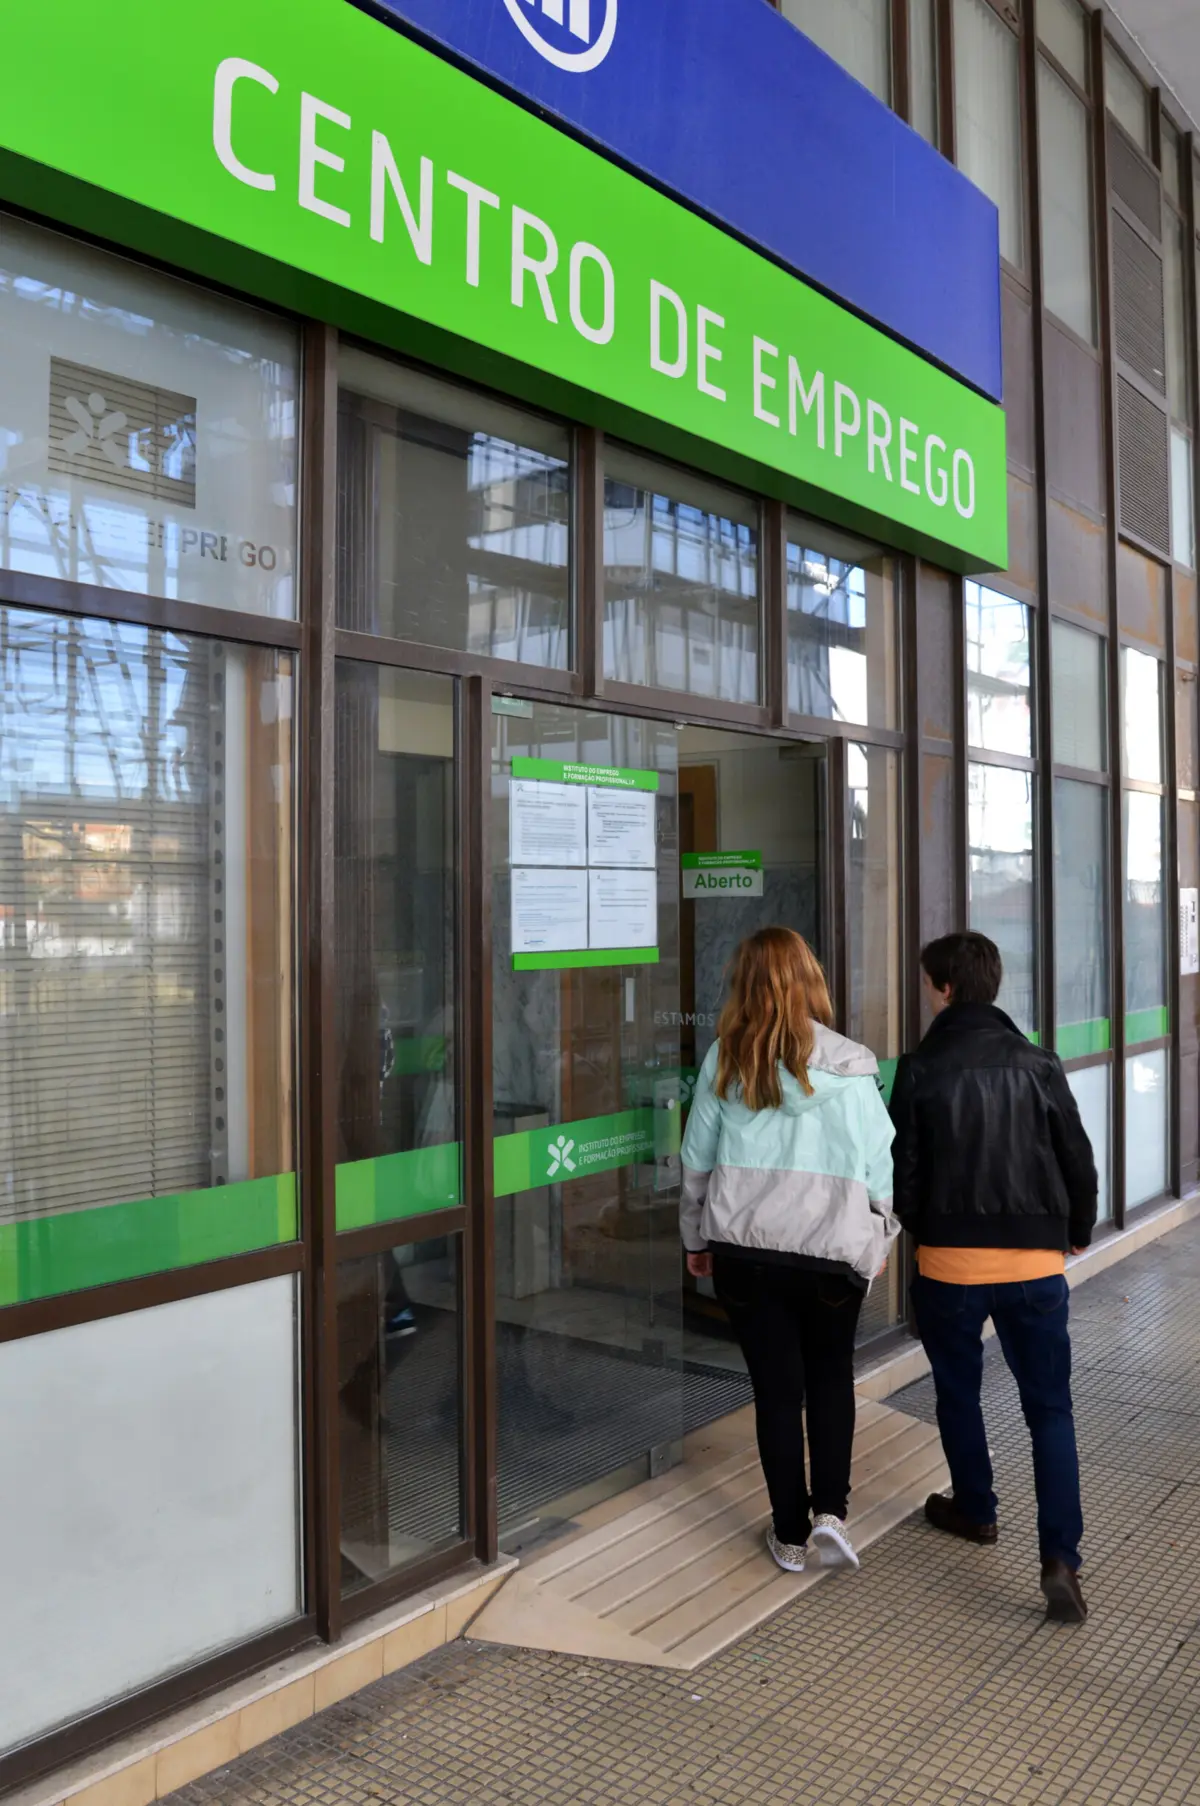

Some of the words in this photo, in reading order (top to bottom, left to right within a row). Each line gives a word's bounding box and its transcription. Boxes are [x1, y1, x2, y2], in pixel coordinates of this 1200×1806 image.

[212, 57, 615, 345] CENTRO
[649, 278, 727, 403] DE
[752, 335, 976, 520] EMPREGO
[694, 872, 753, 889] Aberto
[653, 1010, 715, 1027] ESTAMOS
[578, 1138, 609, 1153] INSTITUTO
[609, 1136, 619, 1146] DO
[578, 1156, 583, 1166] E
[583, 1148, 617, 1164] FORMAÇÃO
